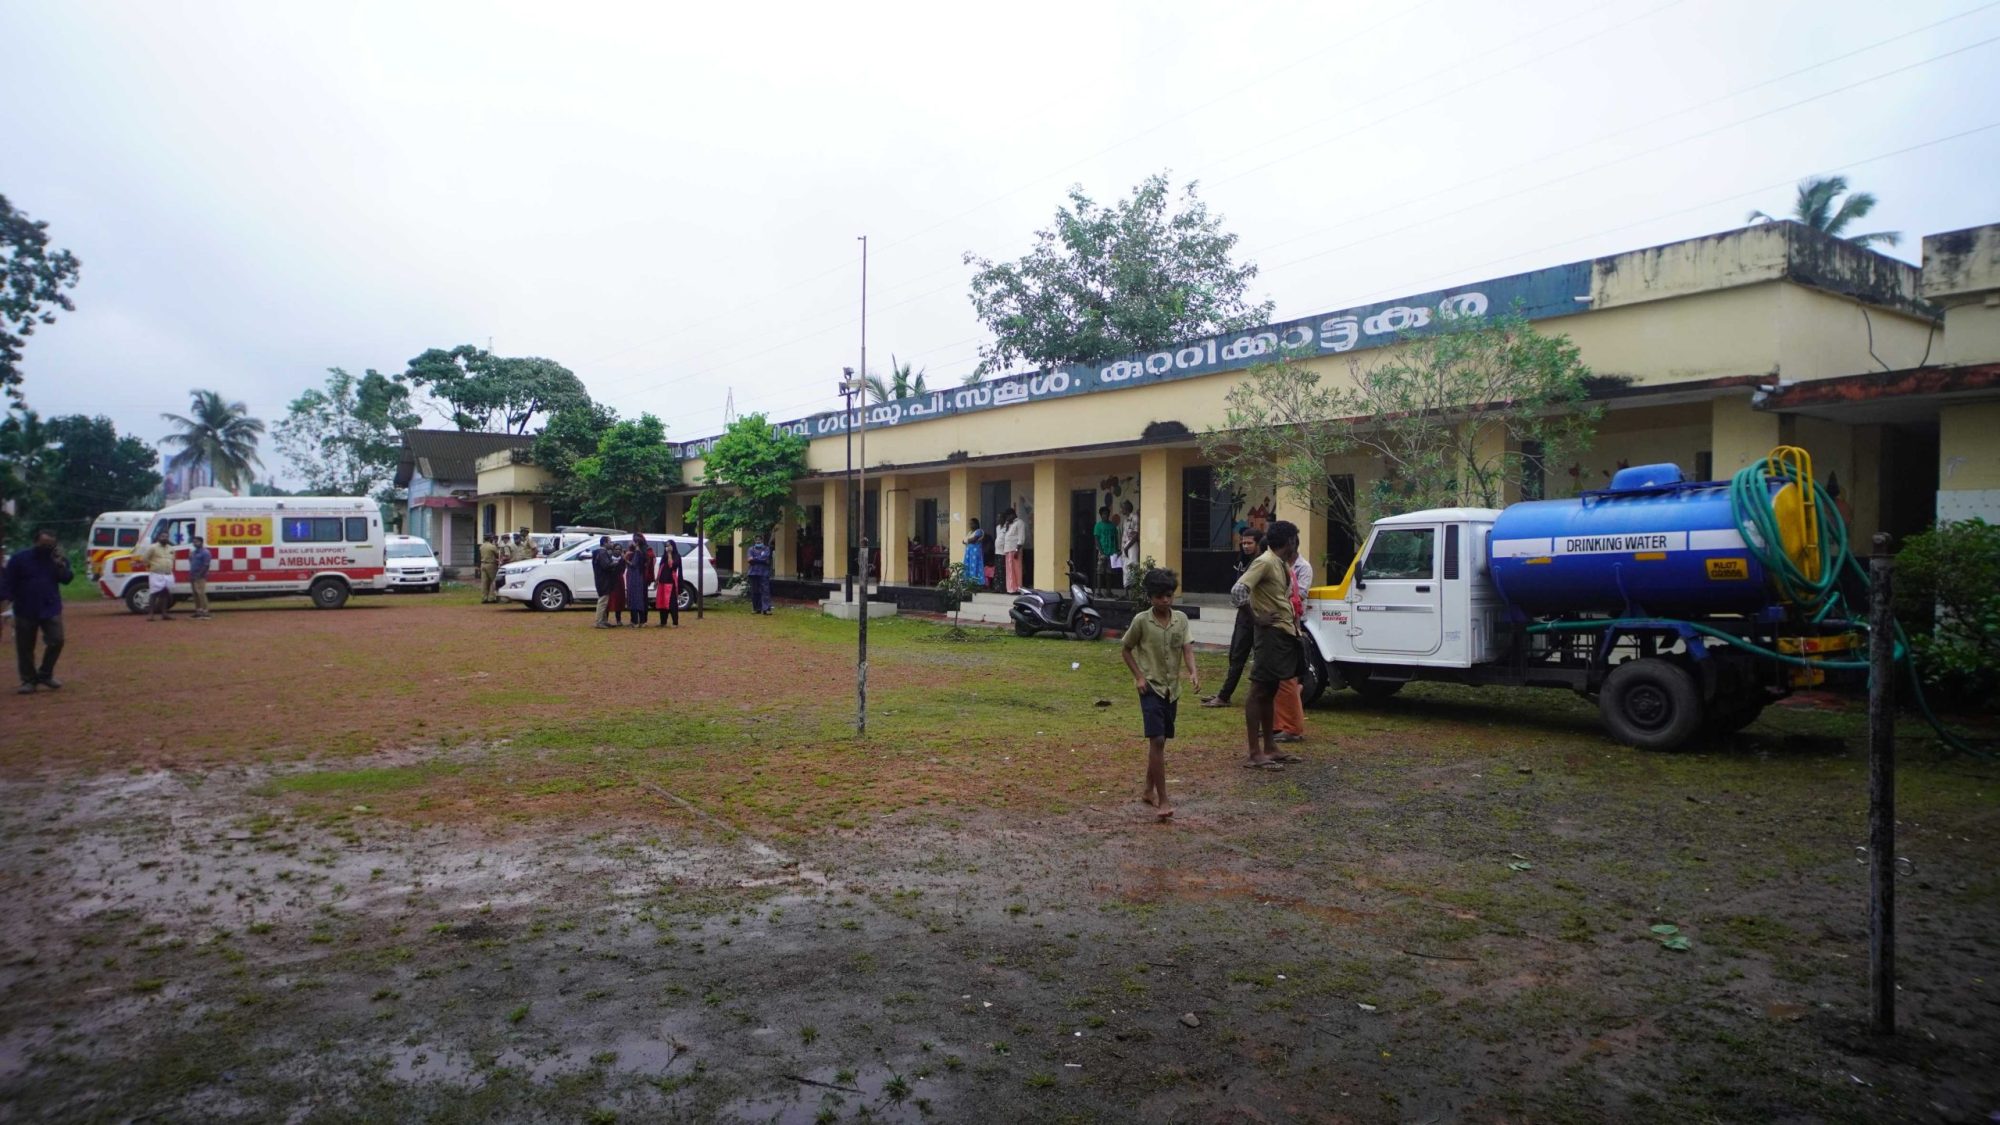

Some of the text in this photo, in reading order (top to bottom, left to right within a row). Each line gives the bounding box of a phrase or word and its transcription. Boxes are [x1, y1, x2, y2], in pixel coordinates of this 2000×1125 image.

[217, 523, 262, 537] 108
[1566, 535, 1668, 553] DRINKING WATER
[279, 556, 348, 567] AMBULANCE
